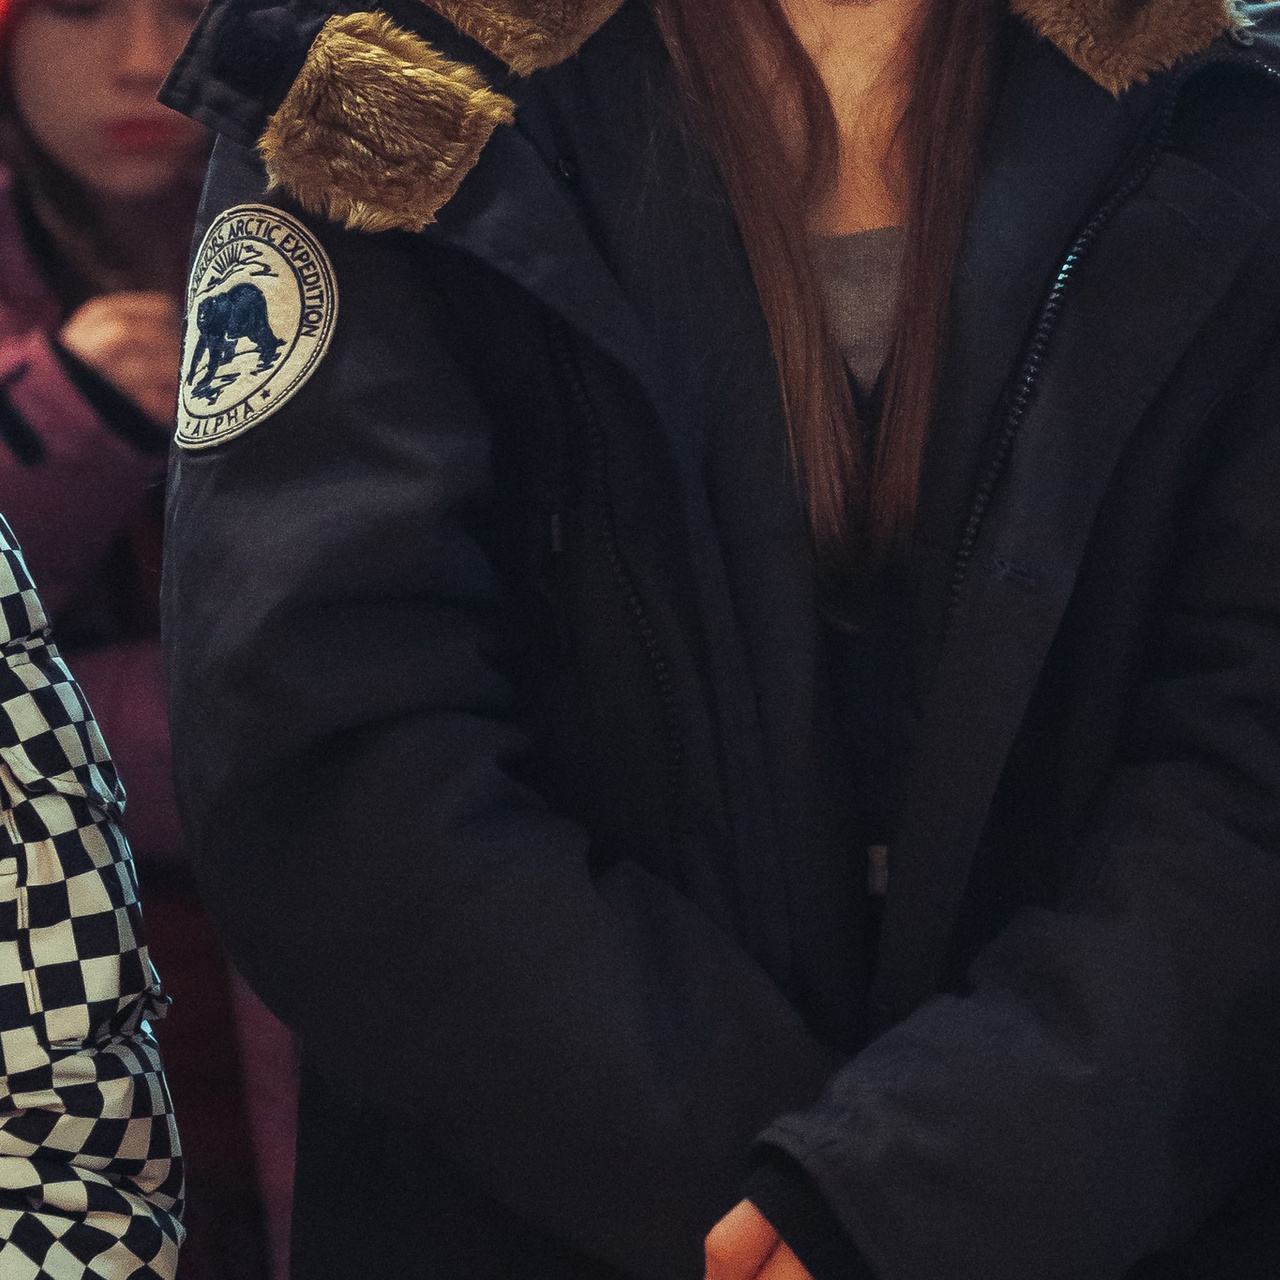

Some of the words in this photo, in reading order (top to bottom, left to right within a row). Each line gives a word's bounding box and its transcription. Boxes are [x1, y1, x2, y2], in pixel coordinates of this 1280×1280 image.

[228, 218, 282, 243] ARCTIC
[280, 233, 324, 338] EXPEDITION
[191, 401, 255, 437] ALPHA
